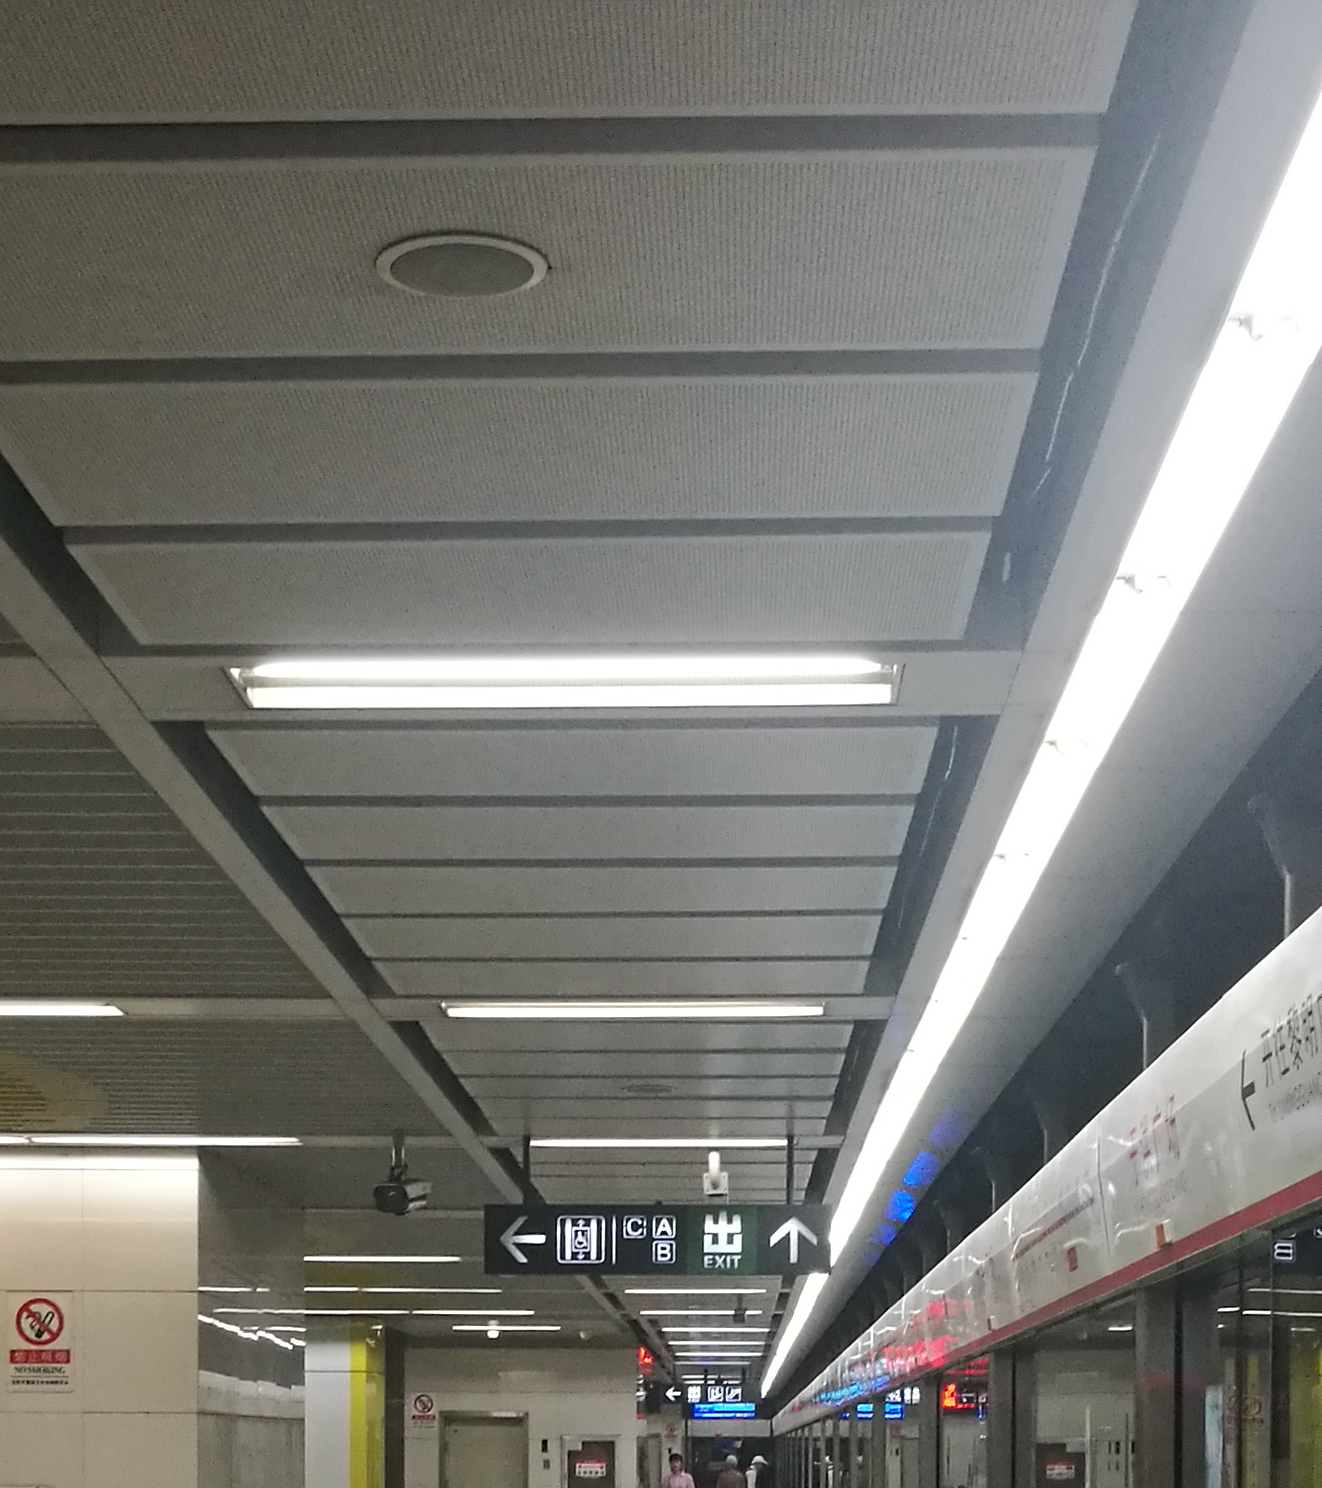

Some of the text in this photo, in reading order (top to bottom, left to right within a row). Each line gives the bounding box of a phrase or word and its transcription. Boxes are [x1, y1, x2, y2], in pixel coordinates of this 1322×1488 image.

[626, 1217, 673, 1236] C A
[656, 1243, 672, 1261] B
[703, 1255, 742, 1269] EXIT
